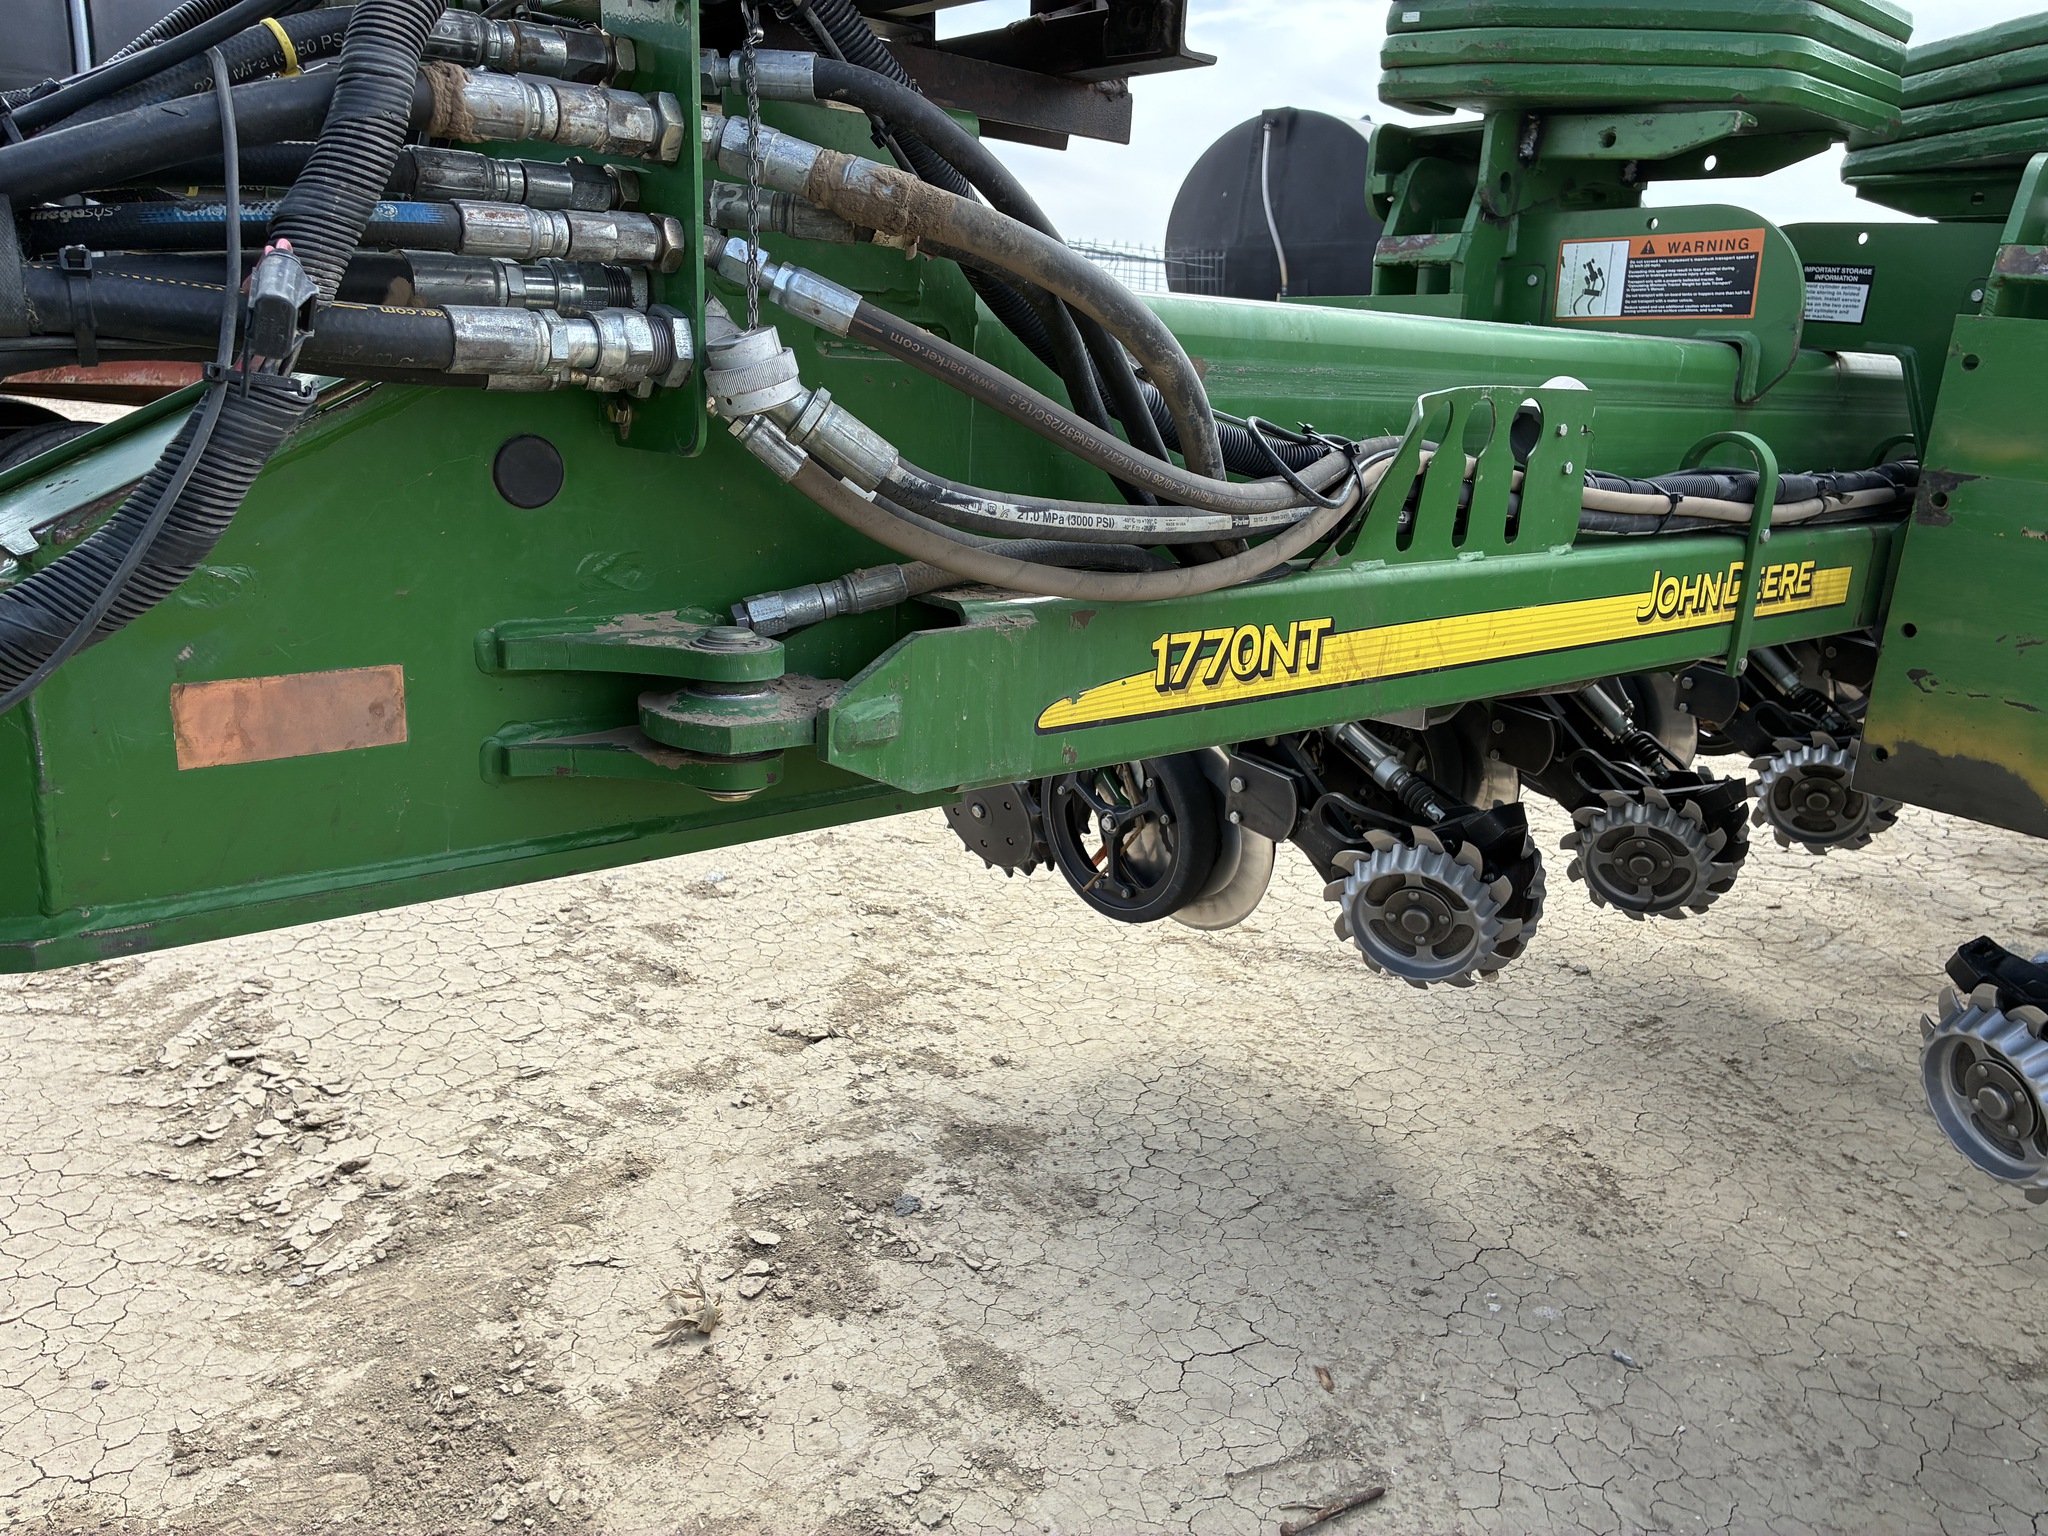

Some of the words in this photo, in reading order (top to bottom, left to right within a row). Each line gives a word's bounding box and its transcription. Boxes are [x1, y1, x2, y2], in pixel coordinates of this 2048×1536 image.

[273, 38, 317, 66] (350
[1667, 237, 1750, 254] WARNING
[1804, 266, 1840, 274] IMPORTANT
[1841, 268, 1873, 276] STORAGE
[1814, 274, 1859, 282] INFORMATION
[380, 306, 448, 319] ker.com
[888, 332, 1000, 395] www.parker.com
[1152, 474, 1189, 495] IC-40/26
[1190, 488, 1212, 504] MSHA
[1018, 511, 1040, 522] 21,0
[1042, 512, 1064, 525] MPa
[1067, 514, 1094, 528] (3000
[1096, 518, 1115, 529] PSI)
[1636, 569, 1724, 624] JOHN
[1723, 560, 1816, 611] DERE
[1152, 616, 1335, 694] 1770NT
